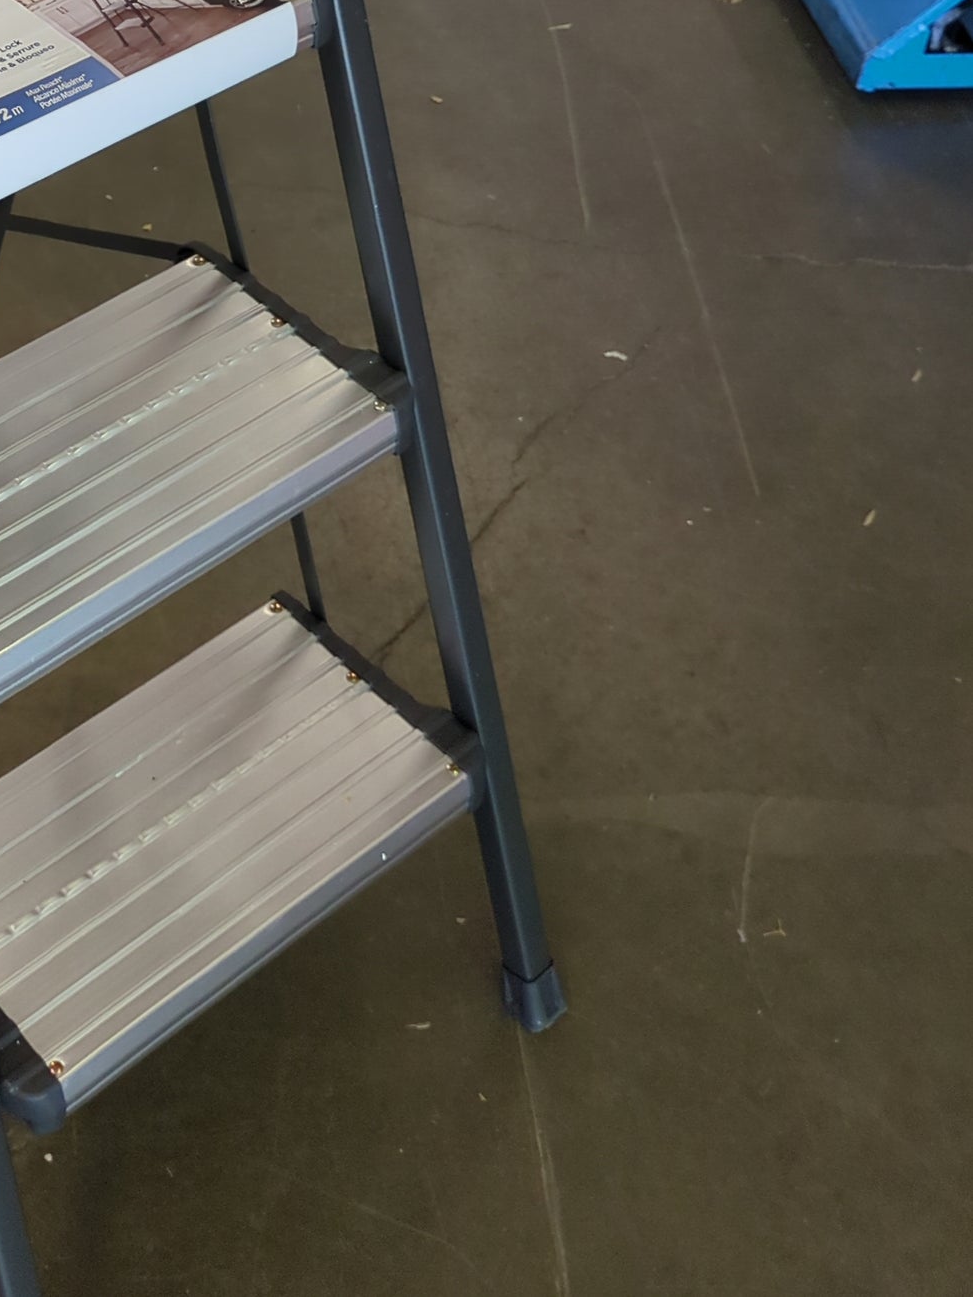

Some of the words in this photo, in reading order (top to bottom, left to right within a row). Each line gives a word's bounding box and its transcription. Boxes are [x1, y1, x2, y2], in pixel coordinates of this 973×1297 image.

[5, 41, 41, 60] Serrure
[15, 43, 55, 64] Bloqueo
[25, 87, 41, 97] Max
[33, 86, 60, 103] Alcance
[11, 105, 24, 116] m
